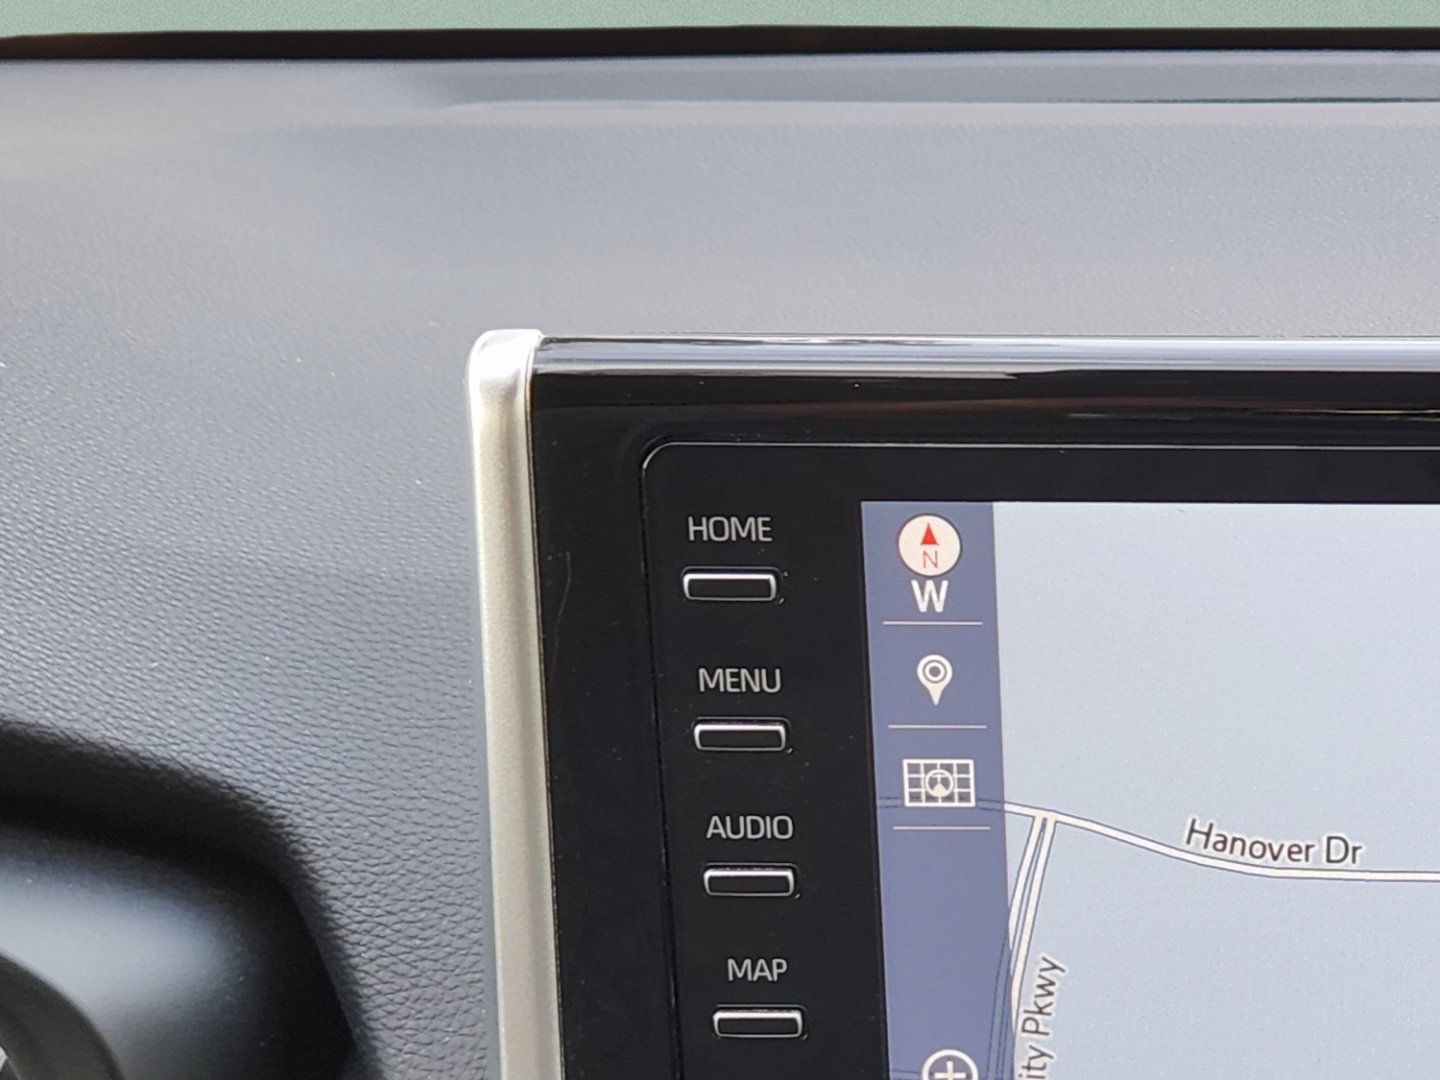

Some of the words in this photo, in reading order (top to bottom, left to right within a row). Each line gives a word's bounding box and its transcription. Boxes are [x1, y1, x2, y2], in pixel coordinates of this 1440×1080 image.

[687, 516, 773, 543] HOME
[922, 550, 938, 569] N
[911, 579, 949, 614] W
[697, 668, 782, 693] MENU
[706, 816, 794, 840] AUDIO
[1186, 818, 1315, 863] Hanover
[1326, 835, 1362, 864] Dr
[727, 958, 788, 982] MAP
[1021, 956, 1066, 1036] Pkwy
